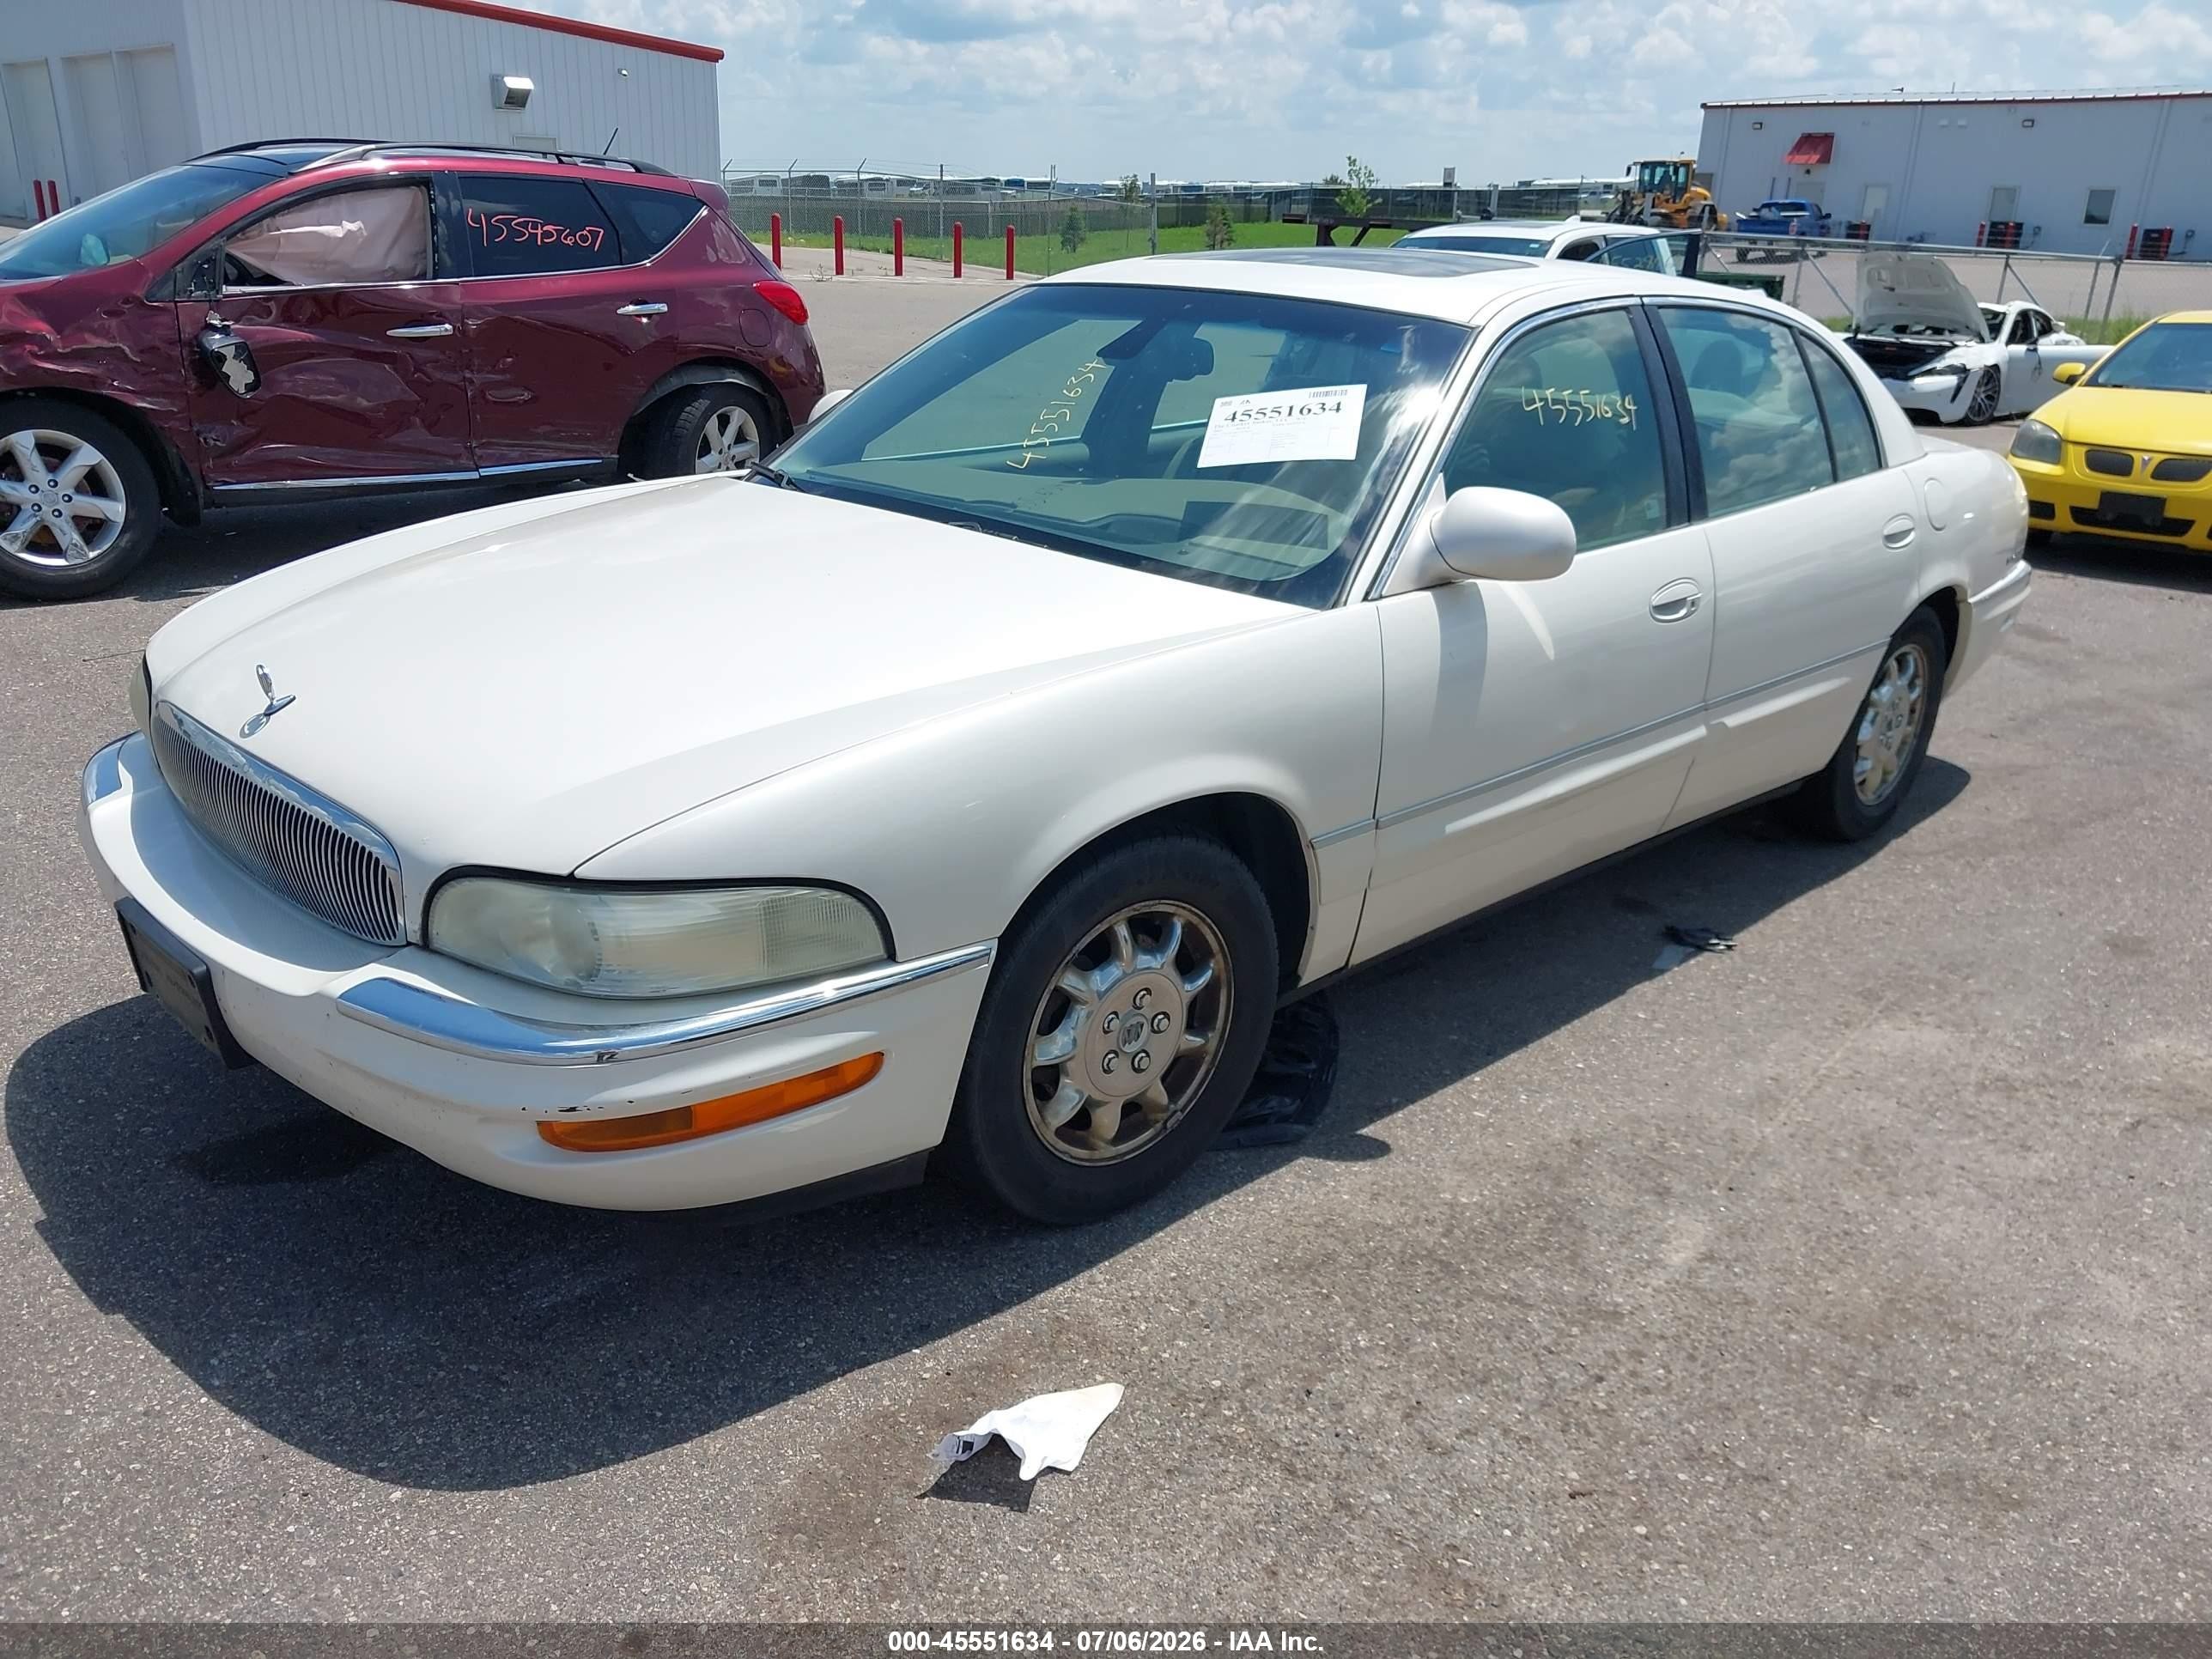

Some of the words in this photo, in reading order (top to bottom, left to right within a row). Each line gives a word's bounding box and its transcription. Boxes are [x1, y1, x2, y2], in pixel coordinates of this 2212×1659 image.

[467, 208, 604, 252] 45545607
[1006, 358, 1106, 469] 45551634
[1224, 400, 1342, 422] 45551634
[1522, 386, 1637, 430] 45551634
